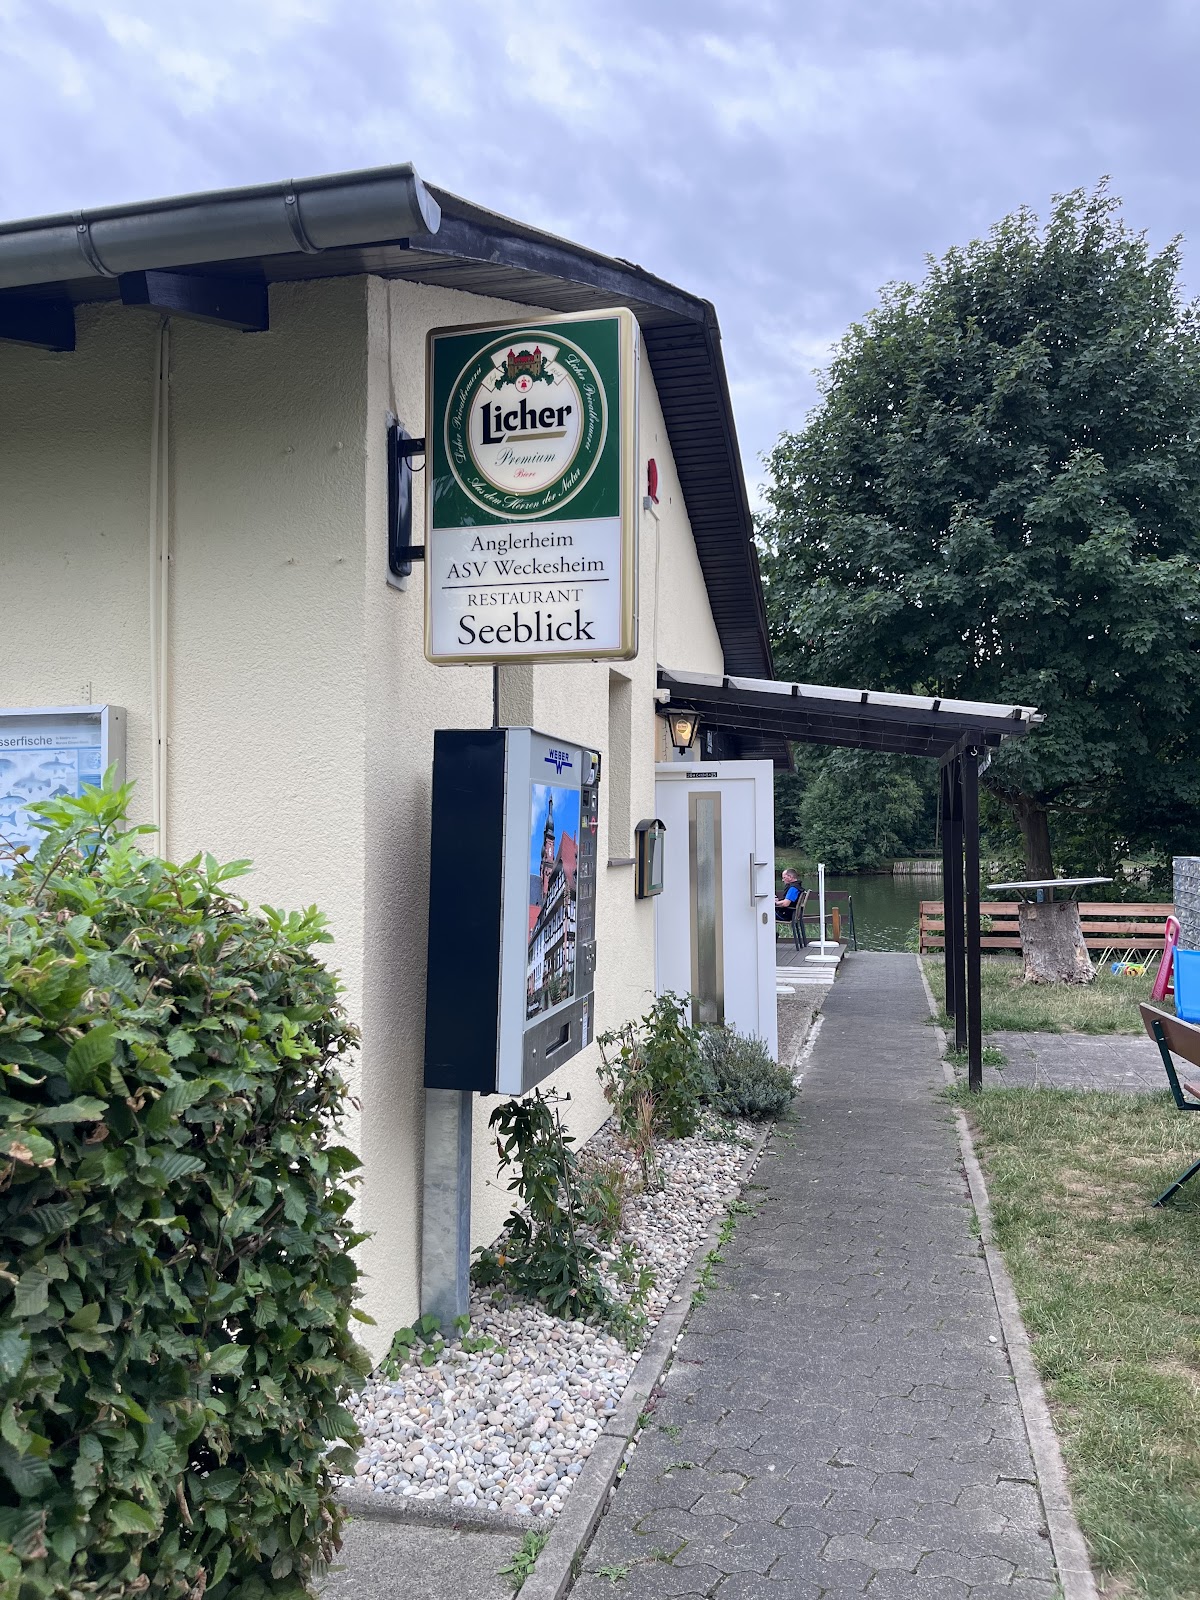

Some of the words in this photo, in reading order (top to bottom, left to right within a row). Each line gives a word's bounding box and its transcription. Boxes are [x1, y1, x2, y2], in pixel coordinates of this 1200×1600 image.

[565, 354, 587, 381] Licher
[480, 398, 572, 445] Licher
[452, 434, 467, 463] Licher
[495, 446, 556, 466] Premium
[467, 477, 487, 495] Aus
[483, 492, 502, 505] dem
[502, 493, 540, 510] Herzen
[542, 491, 557, 505] der
[558, 468, 581, 497] Natur
[471, 532, 574, 555] Anglerheim
[447, 561, 488, 580] ASV
[493, 556, 605, 577] Weckesheim
[467, 588, 584, 607] RESTAURANT
[457, 609, 596, 645] Seeblick
[549, 748, 569, 762] WEBER
